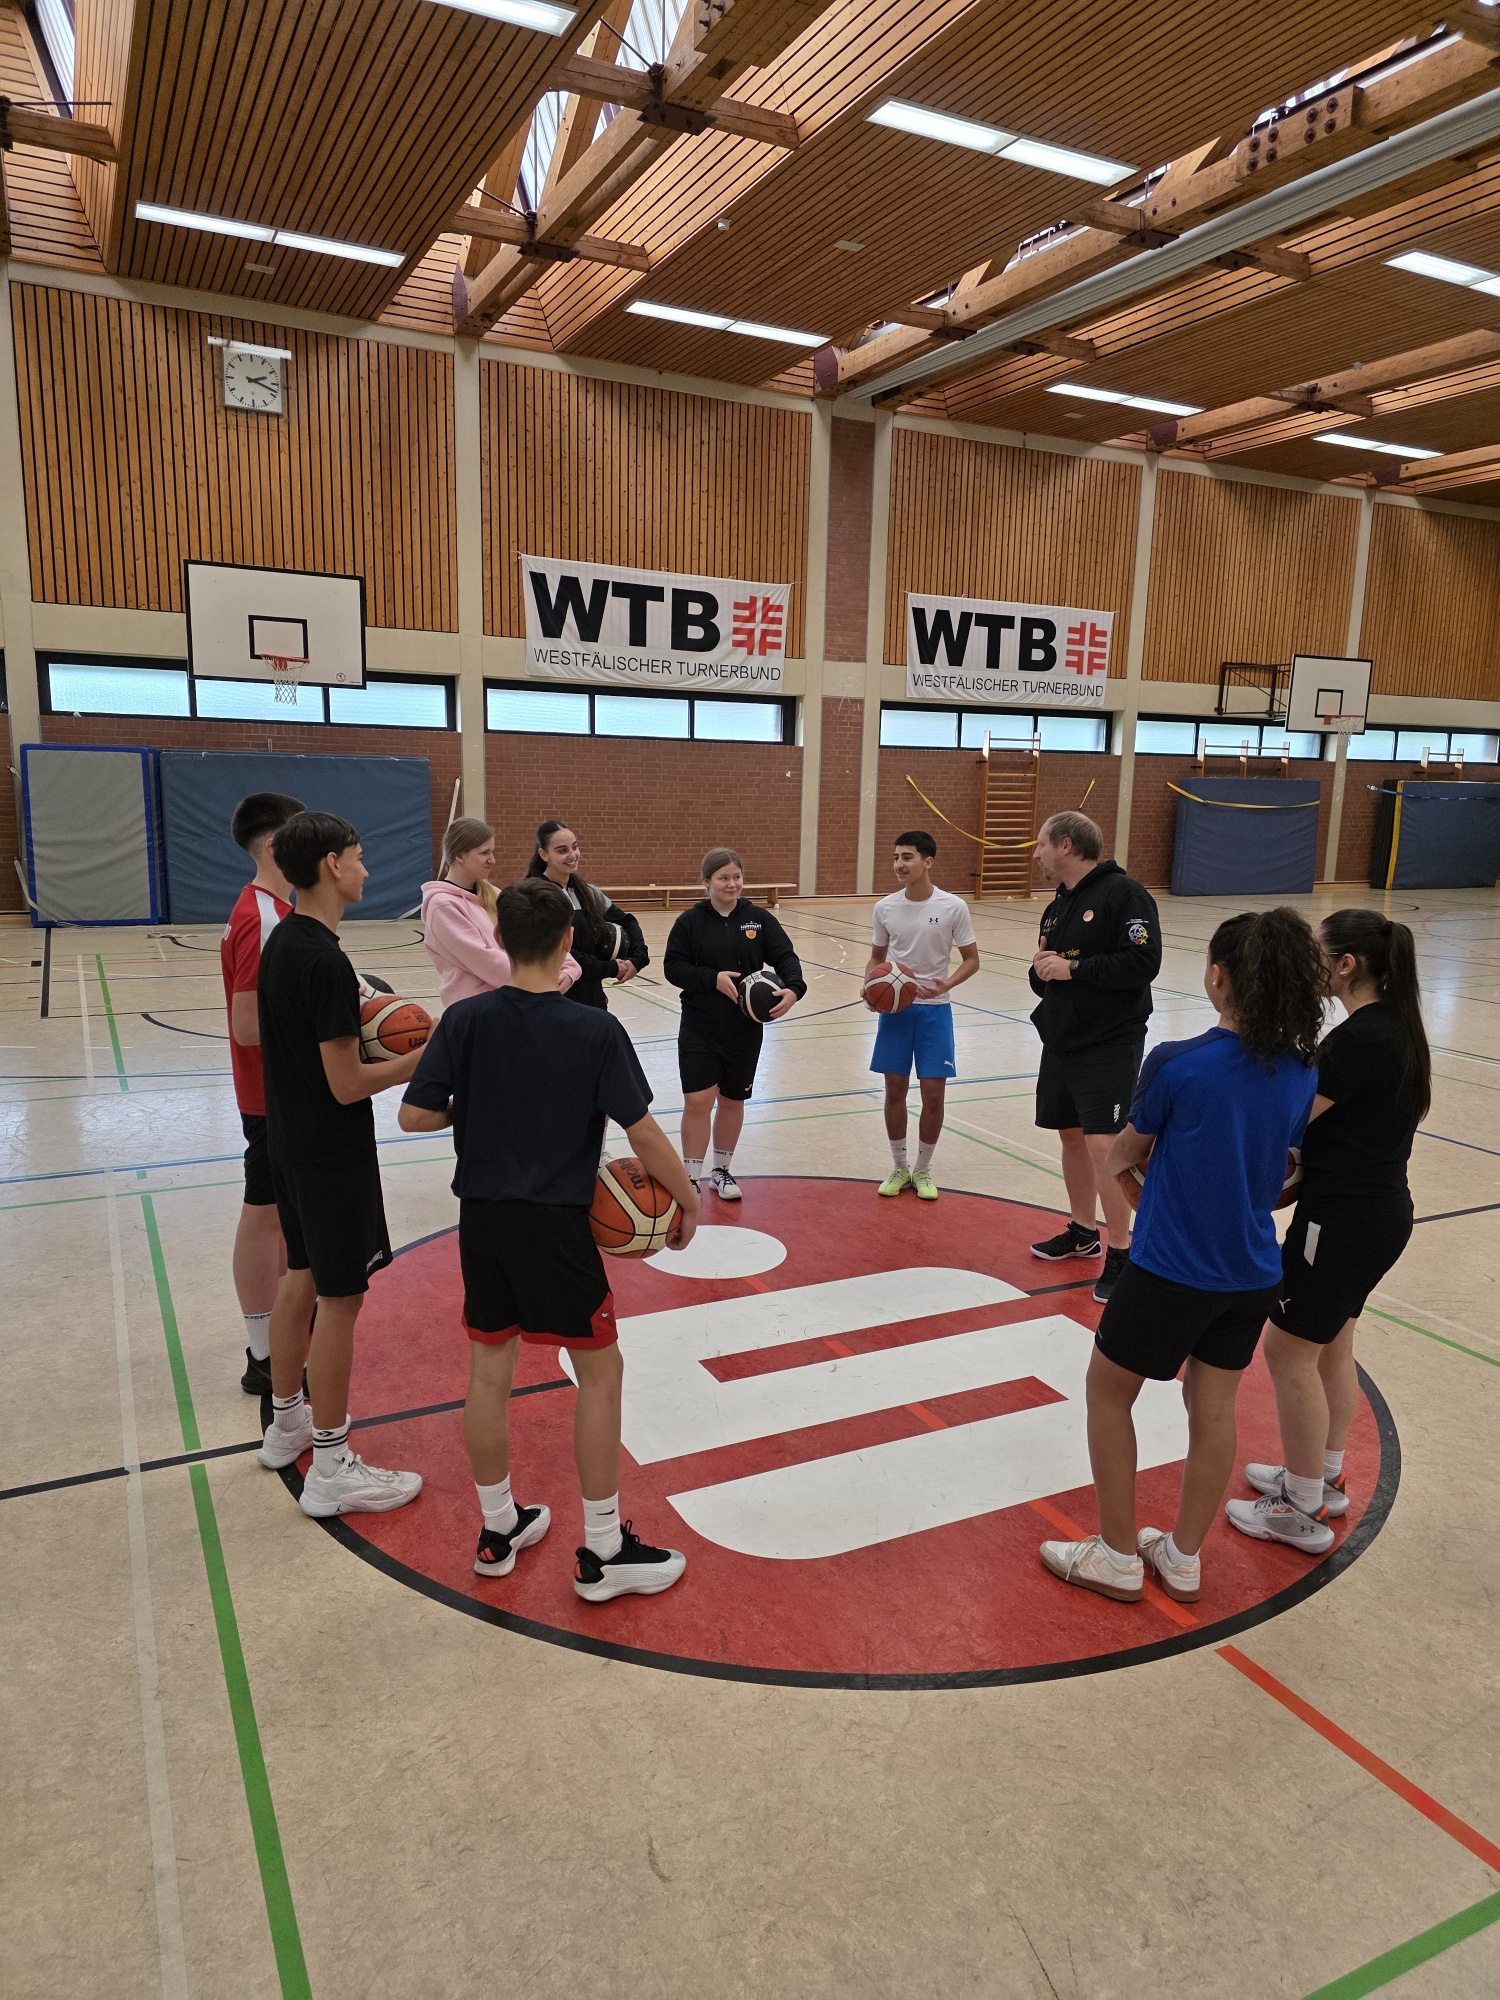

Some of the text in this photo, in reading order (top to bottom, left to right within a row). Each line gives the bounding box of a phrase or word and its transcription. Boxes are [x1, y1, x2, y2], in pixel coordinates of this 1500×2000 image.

[529, 571, 721, 653] WTB
[912, 606, 1058, 672] WTB
[533, 647, 781, 681] WESTFÄLISCHER TURNERBUND
[912, 673, 1104, 698] WESTFÄLISCHER TURNERBUND
[618, 1158, 646, 1190] molte
